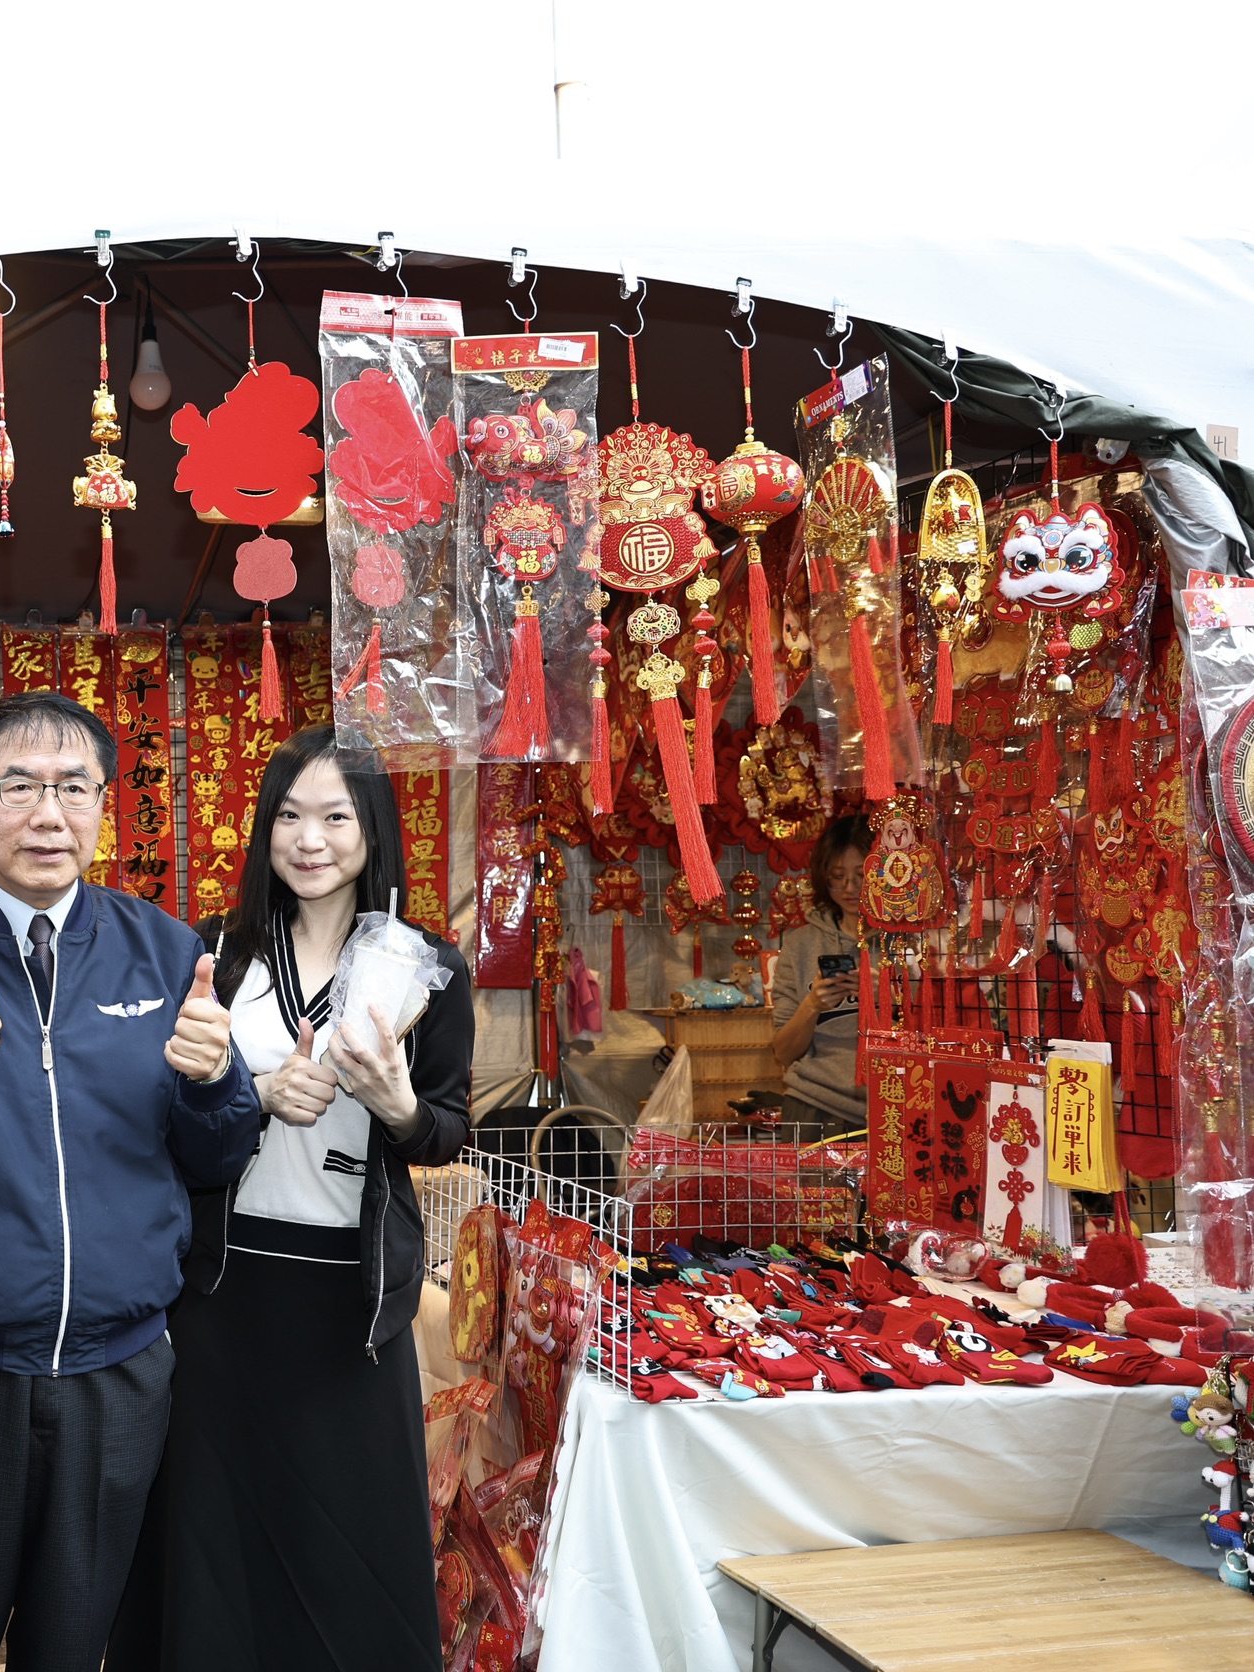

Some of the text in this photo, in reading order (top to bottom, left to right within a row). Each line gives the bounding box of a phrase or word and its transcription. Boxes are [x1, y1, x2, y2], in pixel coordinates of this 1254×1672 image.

[811, 391, 844, 417] ORNAMENTS
[522, 445, 545, 463] 福
[1213, 435, 1227, 457] 41
[517, 549, 541, 574] 福
[624, 529, 670, 571] 福
